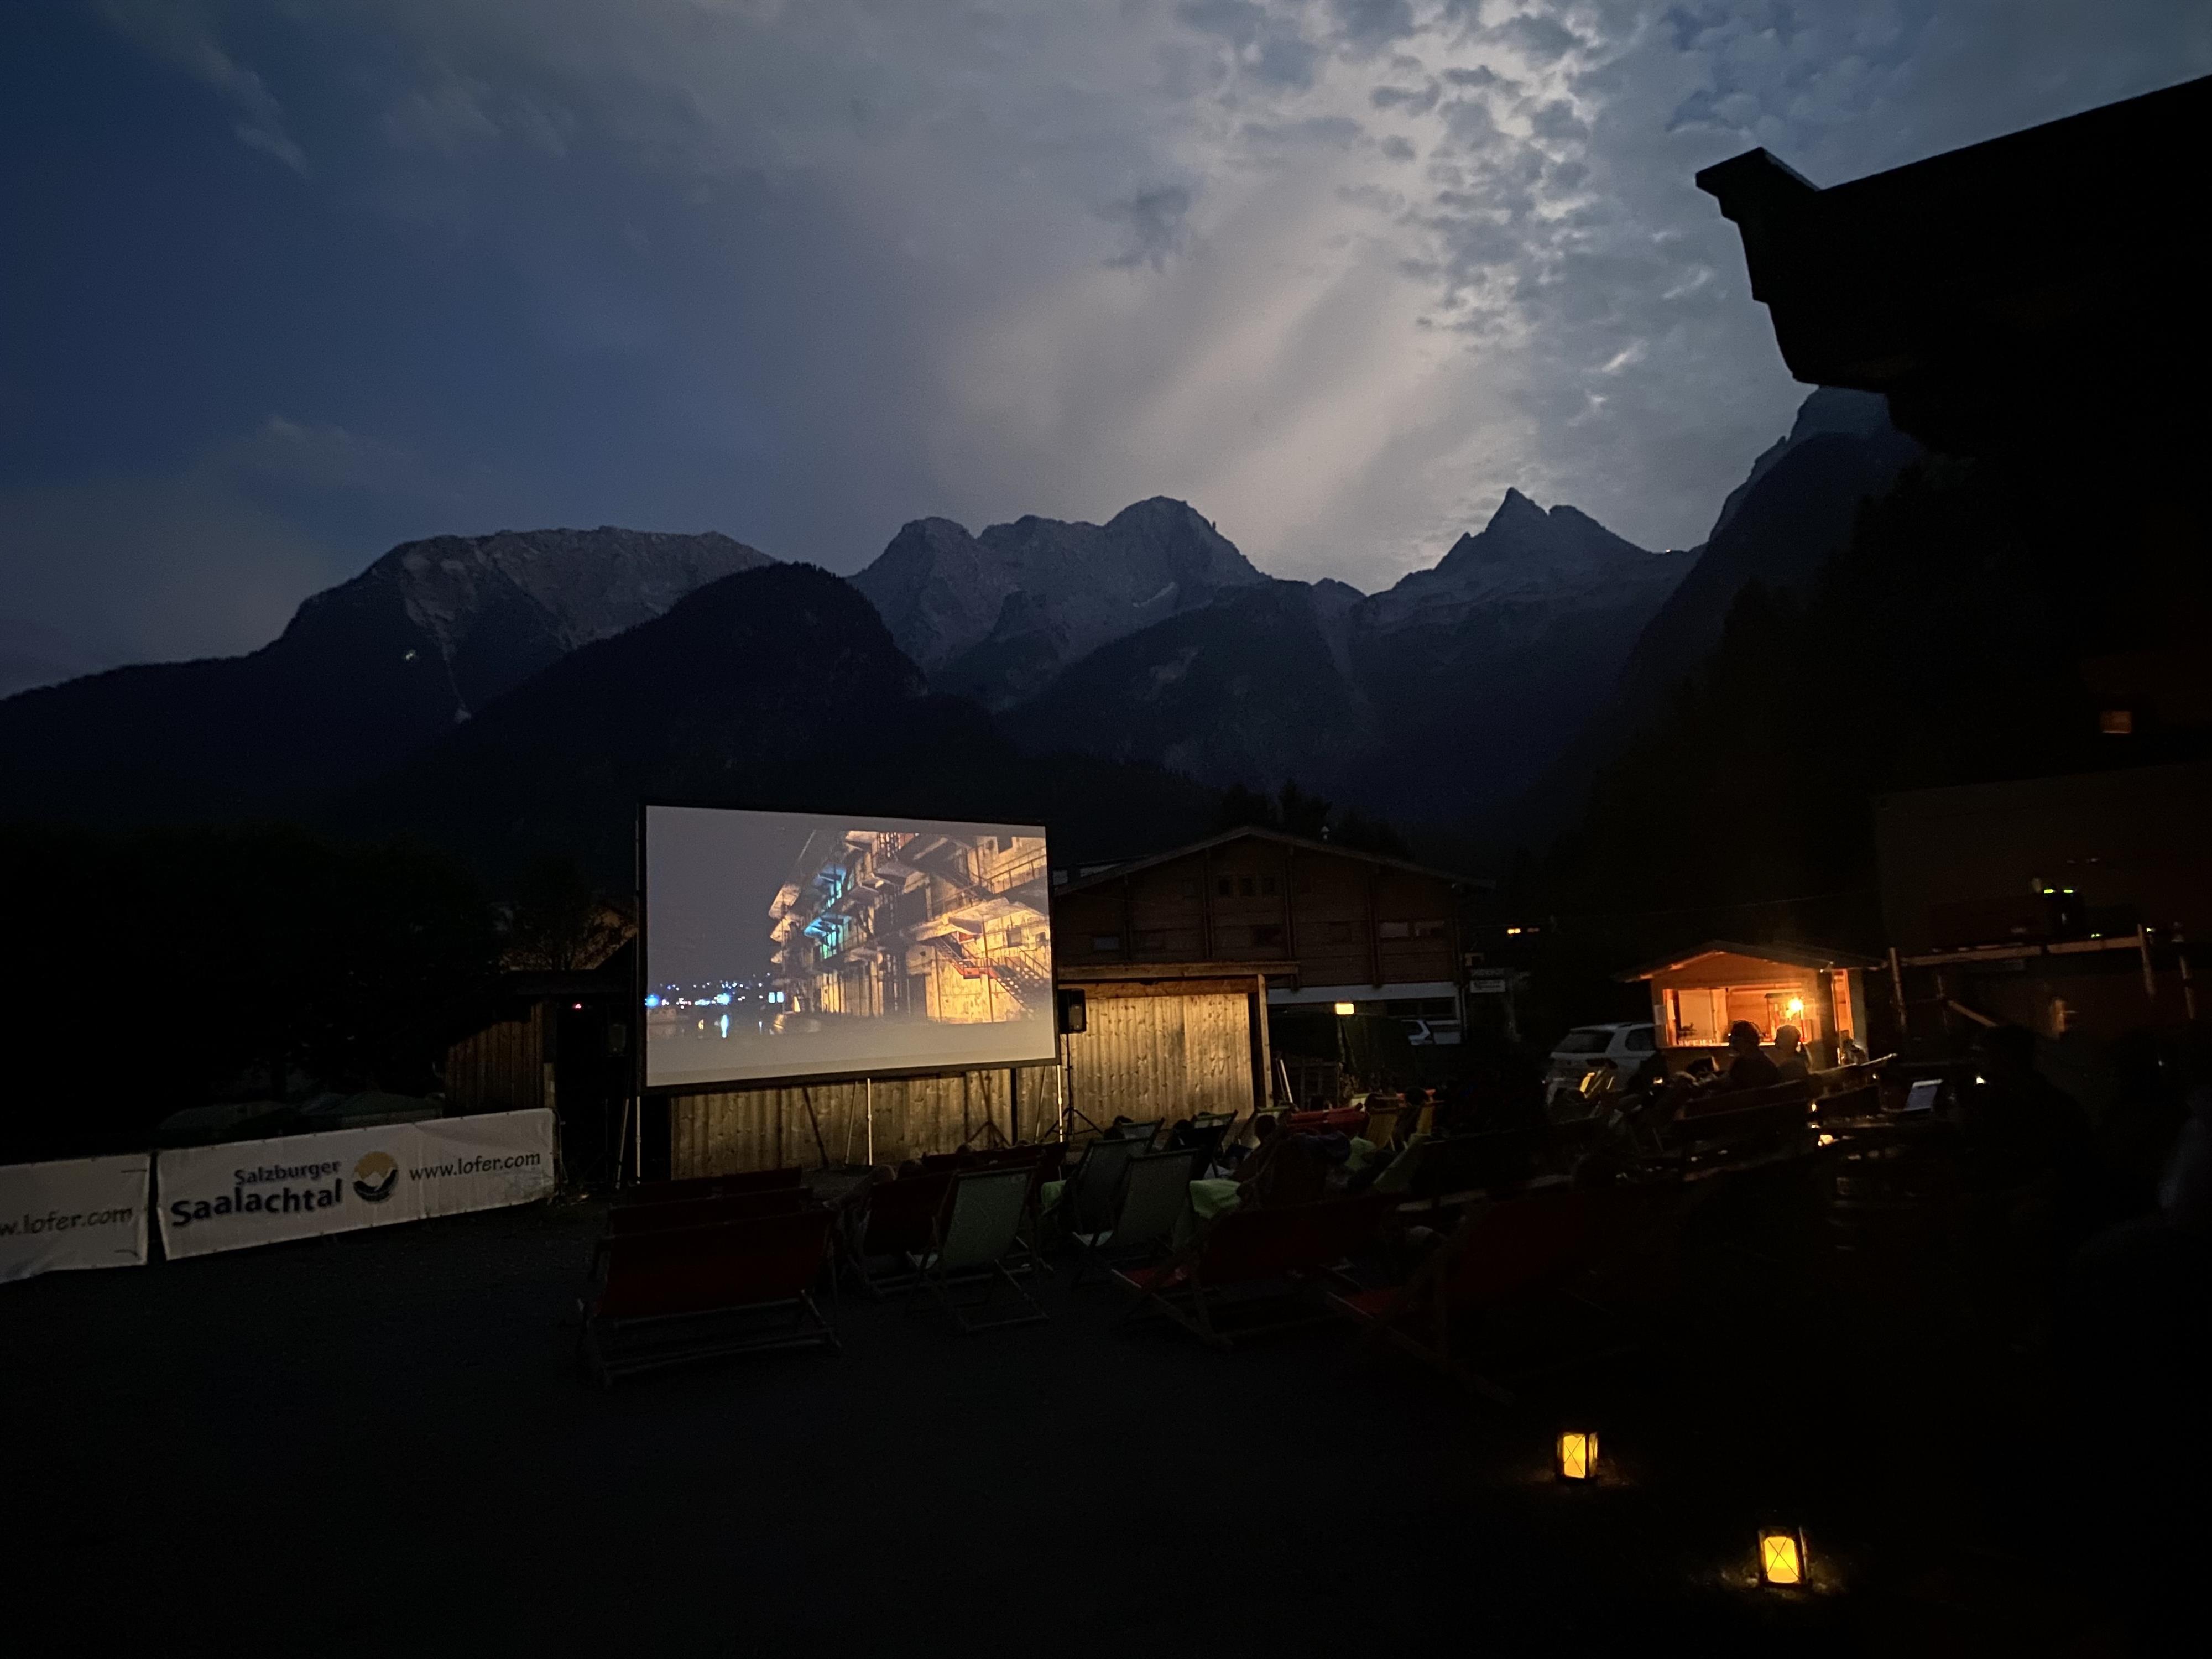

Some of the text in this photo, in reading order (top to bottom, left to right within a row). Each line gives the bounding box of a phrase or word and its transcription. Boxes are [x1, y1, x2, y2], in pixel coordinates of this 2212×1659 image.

[234, 1161, 339, 1185] Salzburger
[409, 1153, 540, 1180] www.lofer.com
[171, 1179, 342, 1227] Saalachtal
